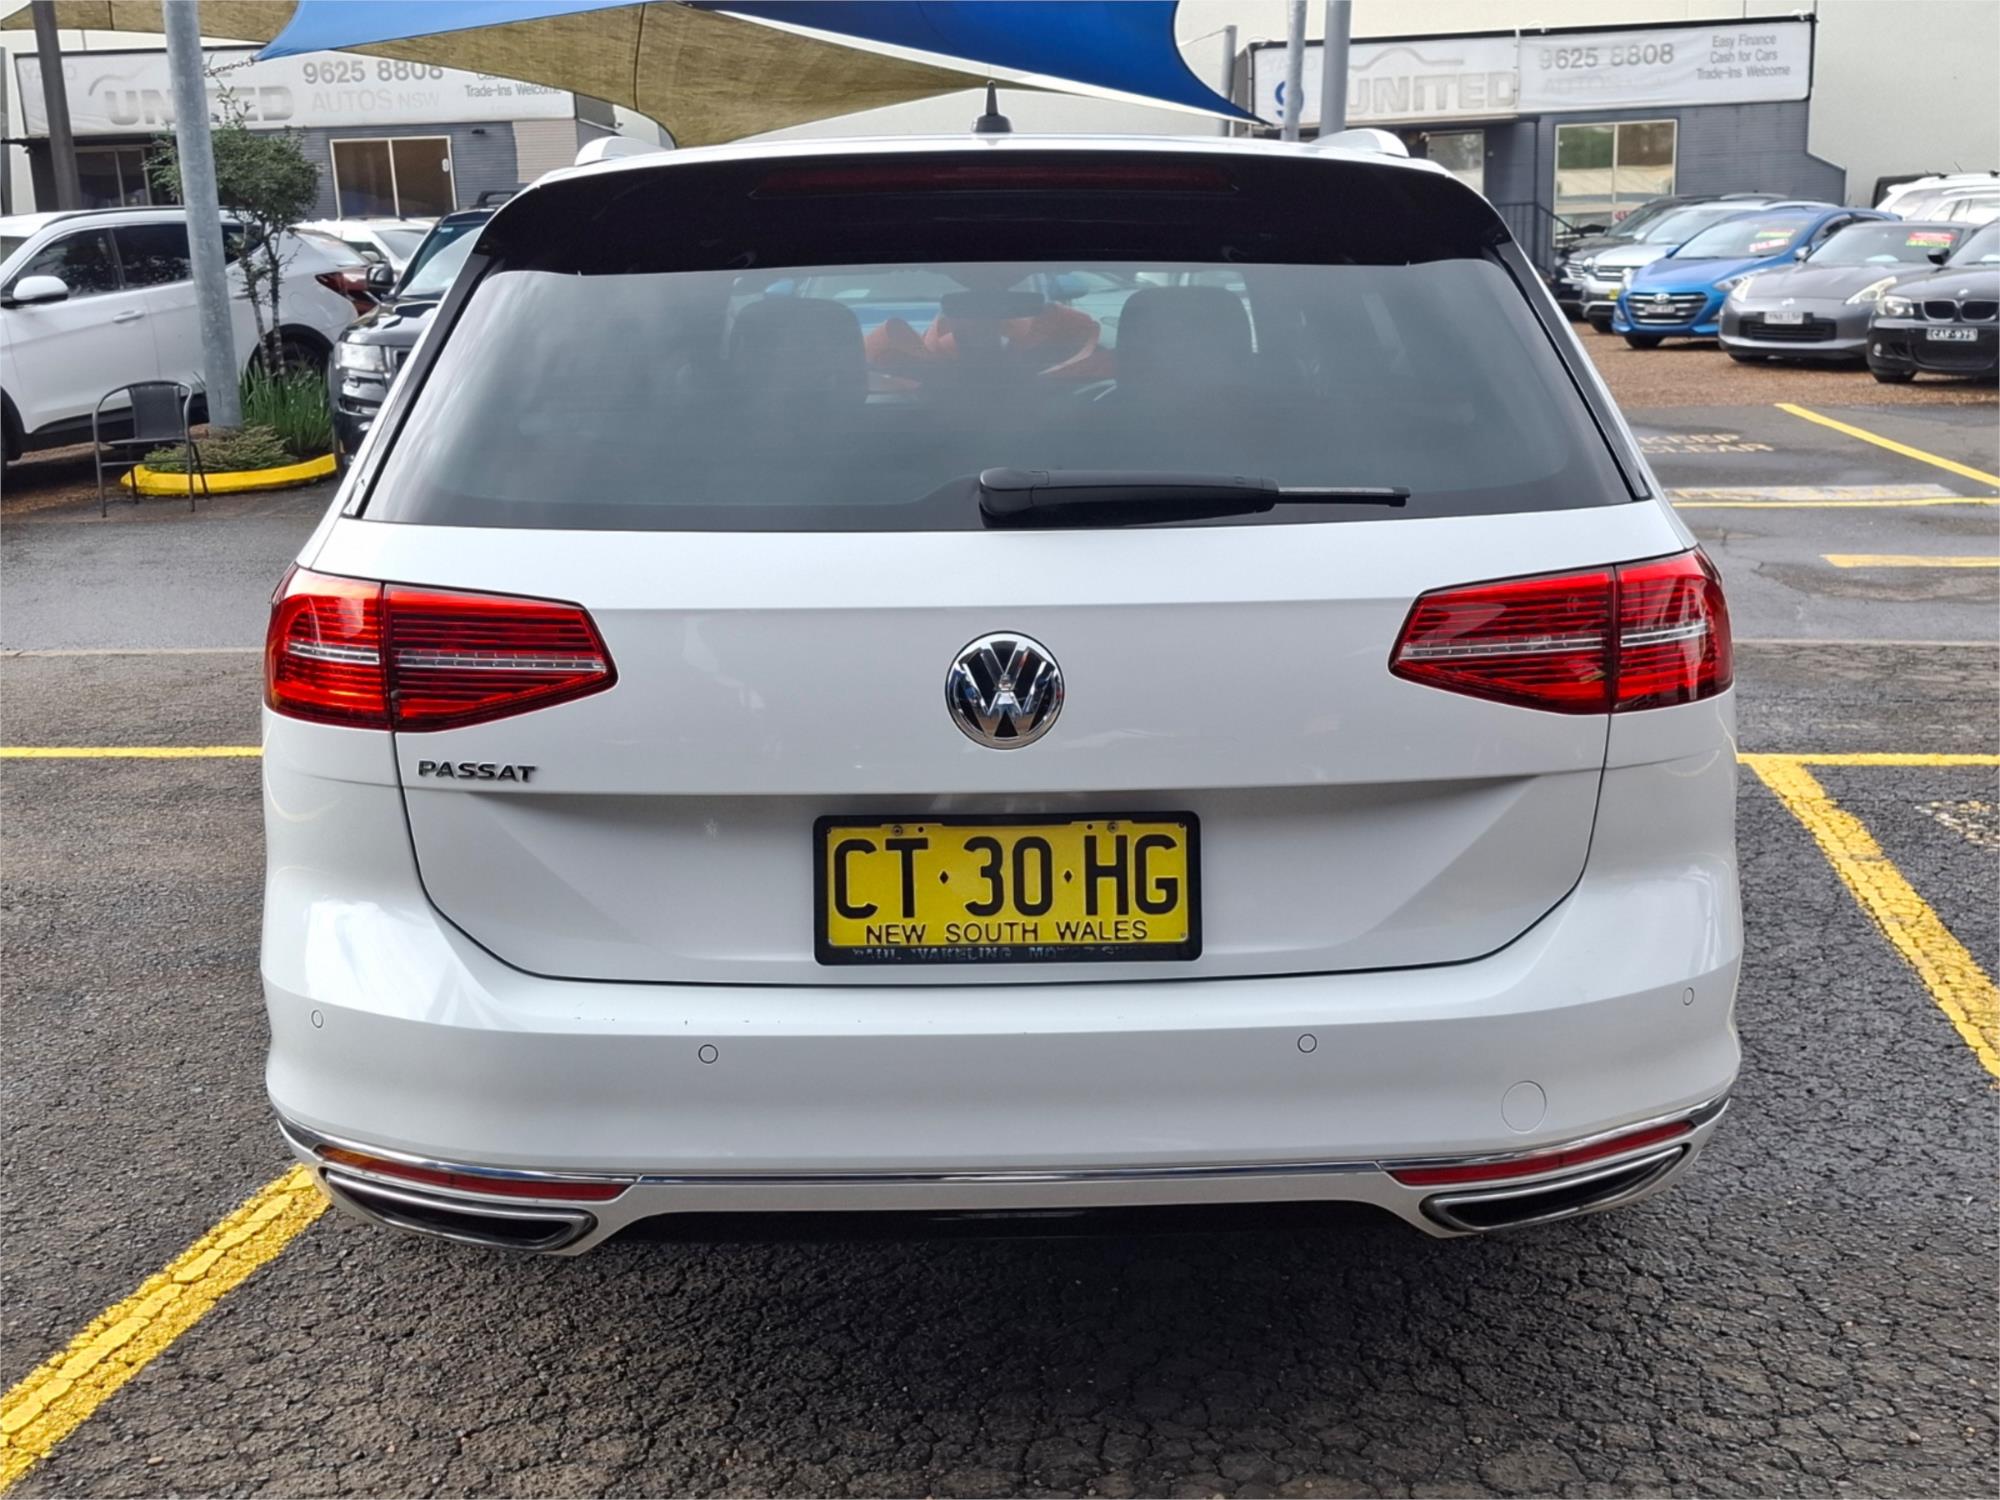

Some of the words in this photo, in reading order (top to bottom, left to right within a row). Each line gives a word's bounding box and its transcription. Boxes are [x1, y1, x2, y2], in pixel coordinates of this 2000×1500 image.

[1738, 33, 1777, 47] Finance
[1540, 46, 1600, 71] 9625
[1609, 42, 1675, 67] 8808
[1710, 50, 1735, 64] Cash
[1755, 48, 1778, 62] Cars
[303, 61, 366, 85] 9625
[376, 59, 444, 82] 8808
[311, 88, 393, 113] AUTOS
[397, 90, 440, 111] NSW
[464, 83, 512, 98] Trade-Ins
[417, 759, 537, 783] PASSAT
[866, 923, 926, 945] NEW
[945, 921, 1039, 944] SOUTH
[1056, 919, 1148, 942] WALES
